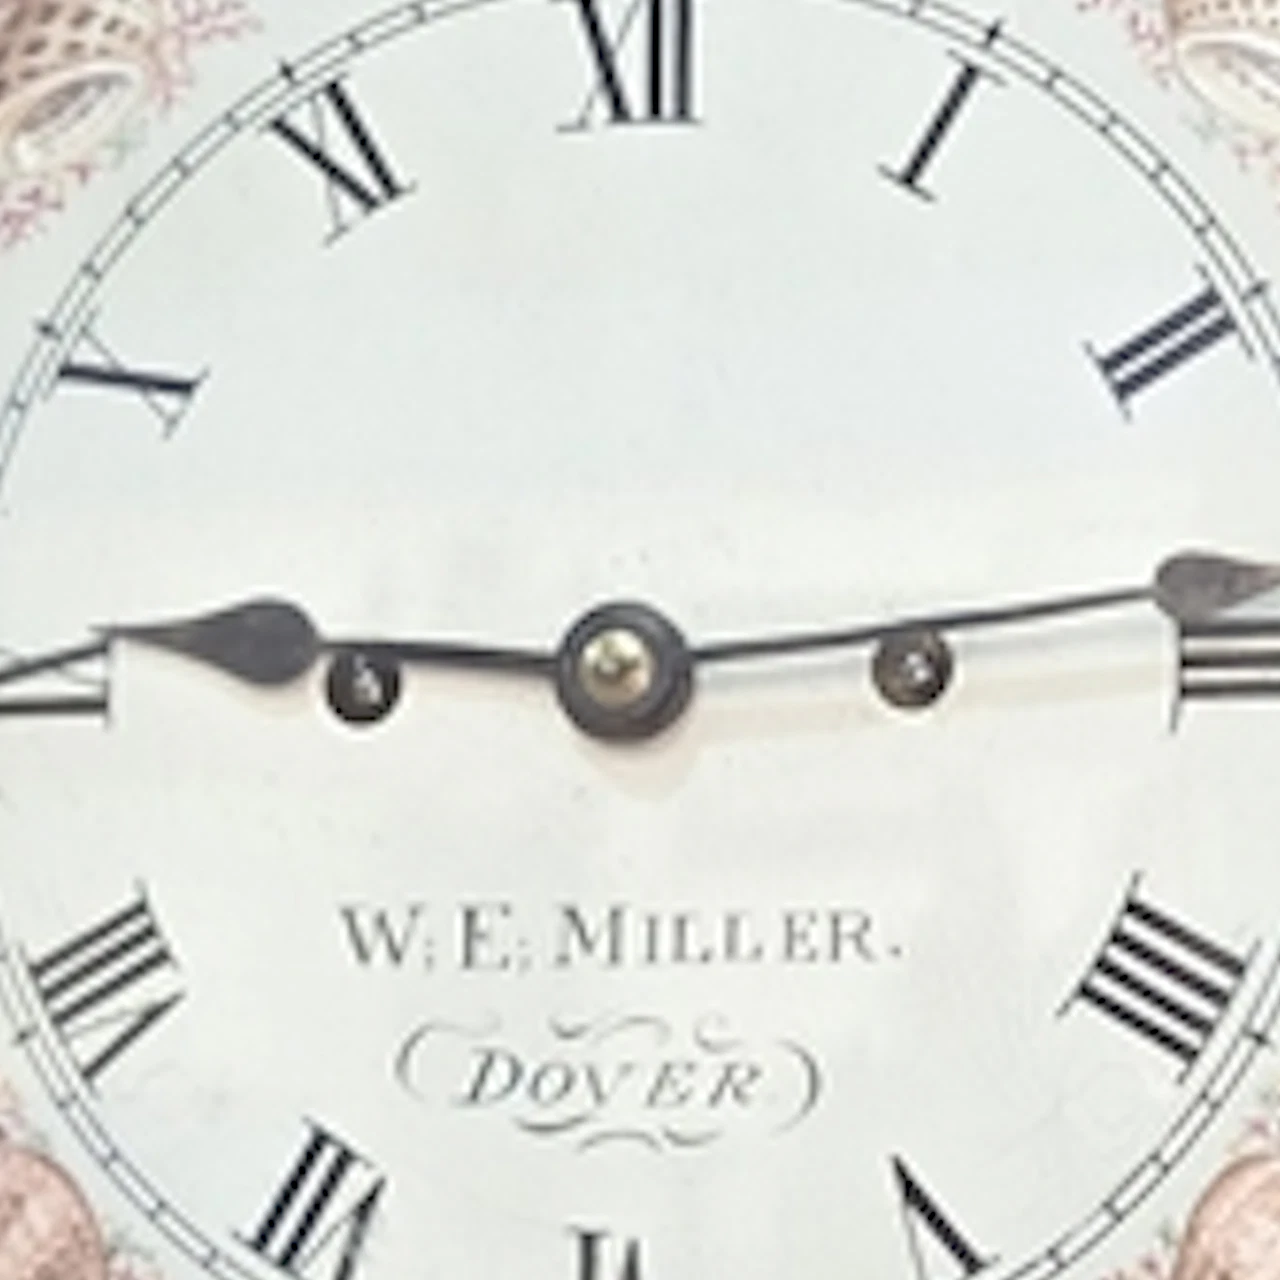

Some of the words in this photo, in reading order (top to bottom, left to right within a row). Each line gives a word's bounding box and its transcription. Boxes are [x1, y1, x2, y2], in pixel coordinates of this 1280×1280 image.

[268, 72, 416, 242] XI
[877, 51, 1005, 201] I
[42, 312, 208, 436] X
[1084, 266, 1256, 418] II
[554, 902, 906, 968] MILLER.
[454, 1046, 764, 1108] DOVER
